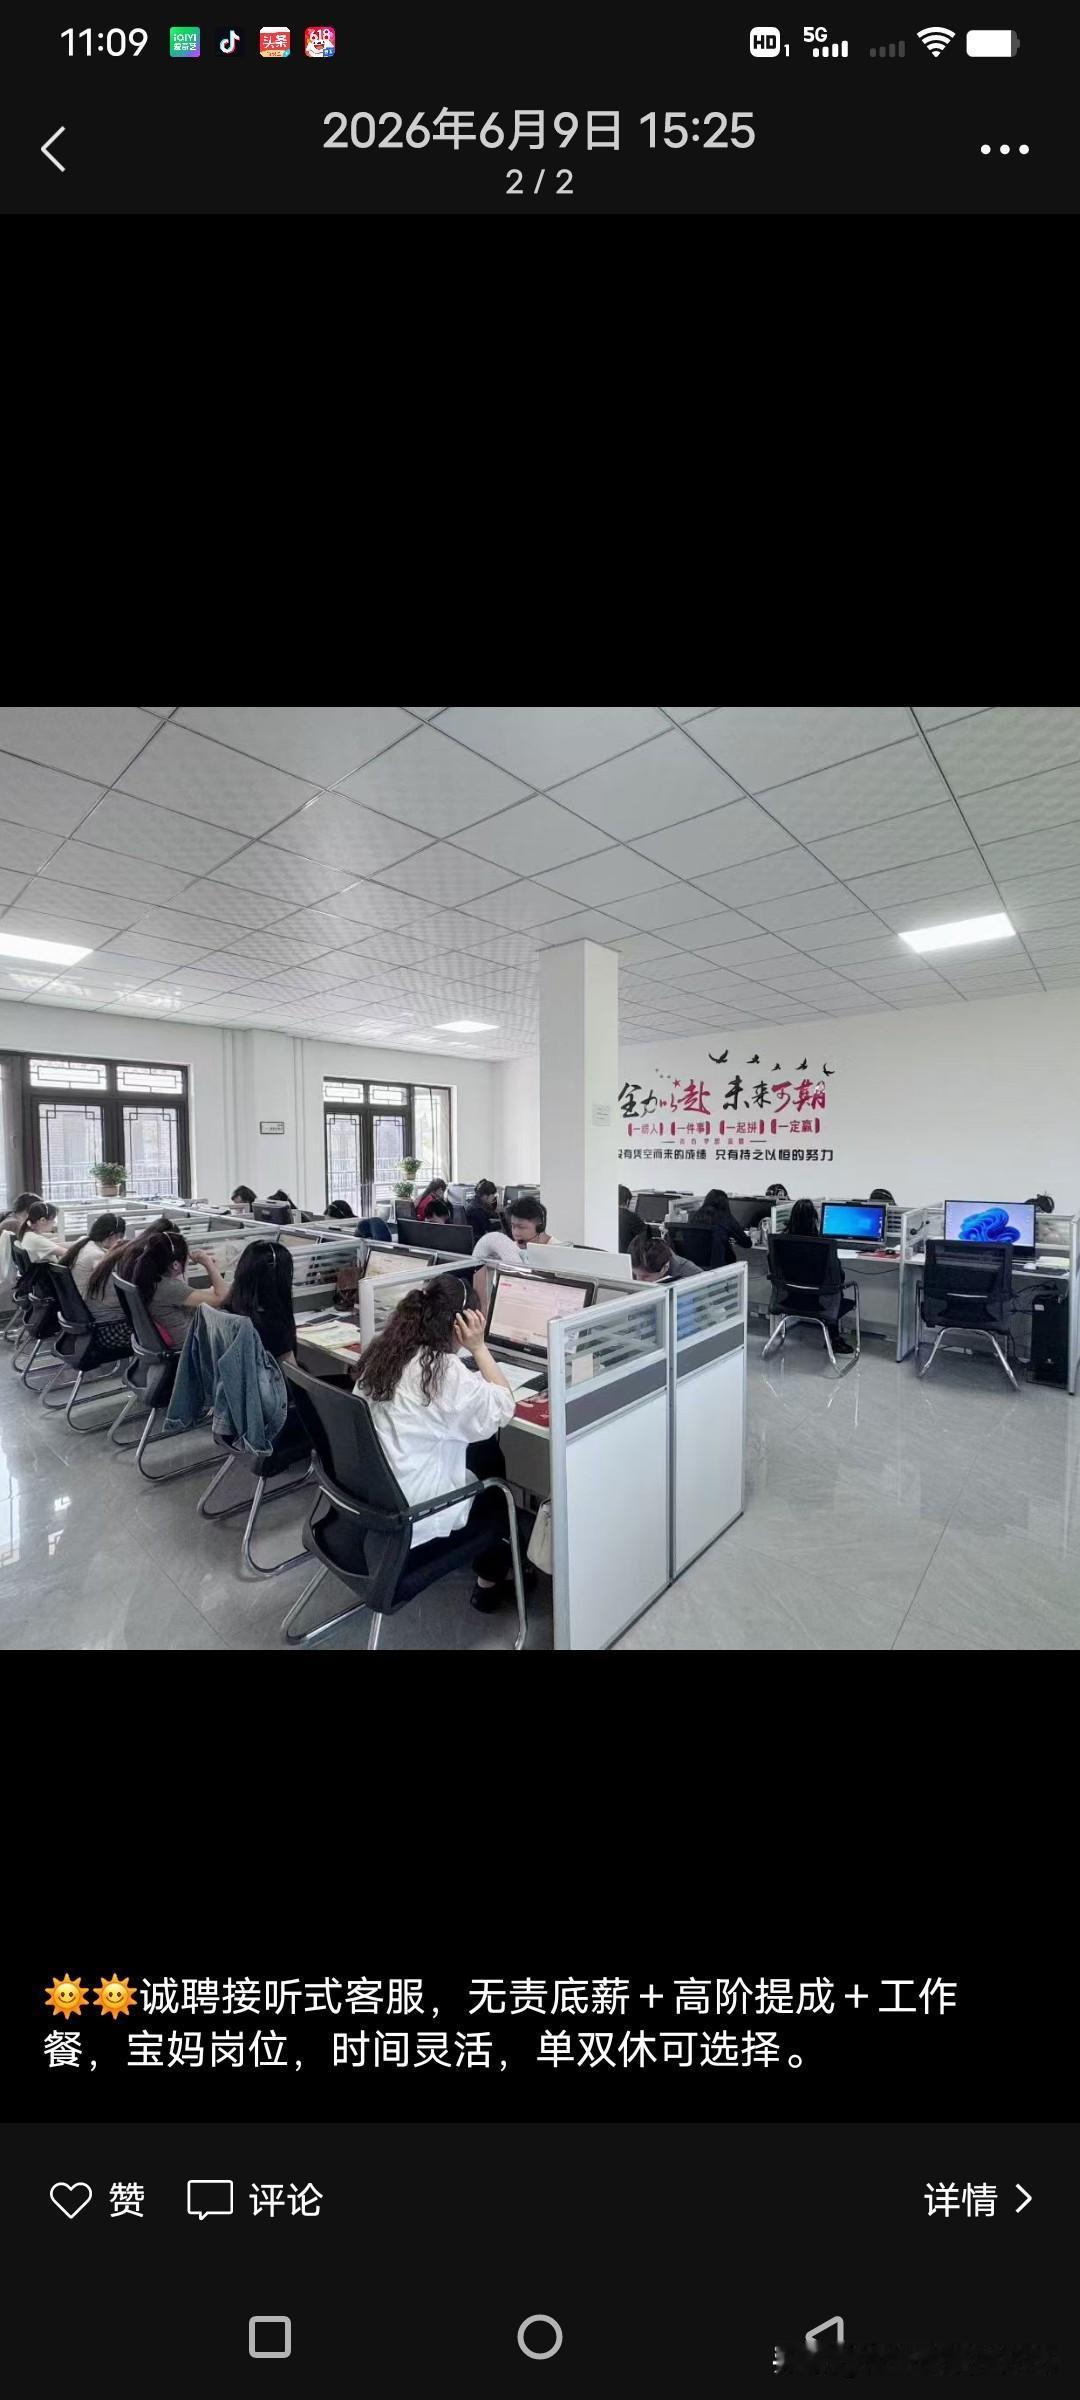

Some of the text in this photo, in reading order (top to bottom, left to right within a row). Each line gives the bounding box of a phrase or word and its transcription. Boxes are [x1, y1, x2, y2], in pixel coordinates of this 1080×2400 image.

[617, 1079, 711, 1118] 全力以赴
[722, 1075, 826, 1113] 未来可期
